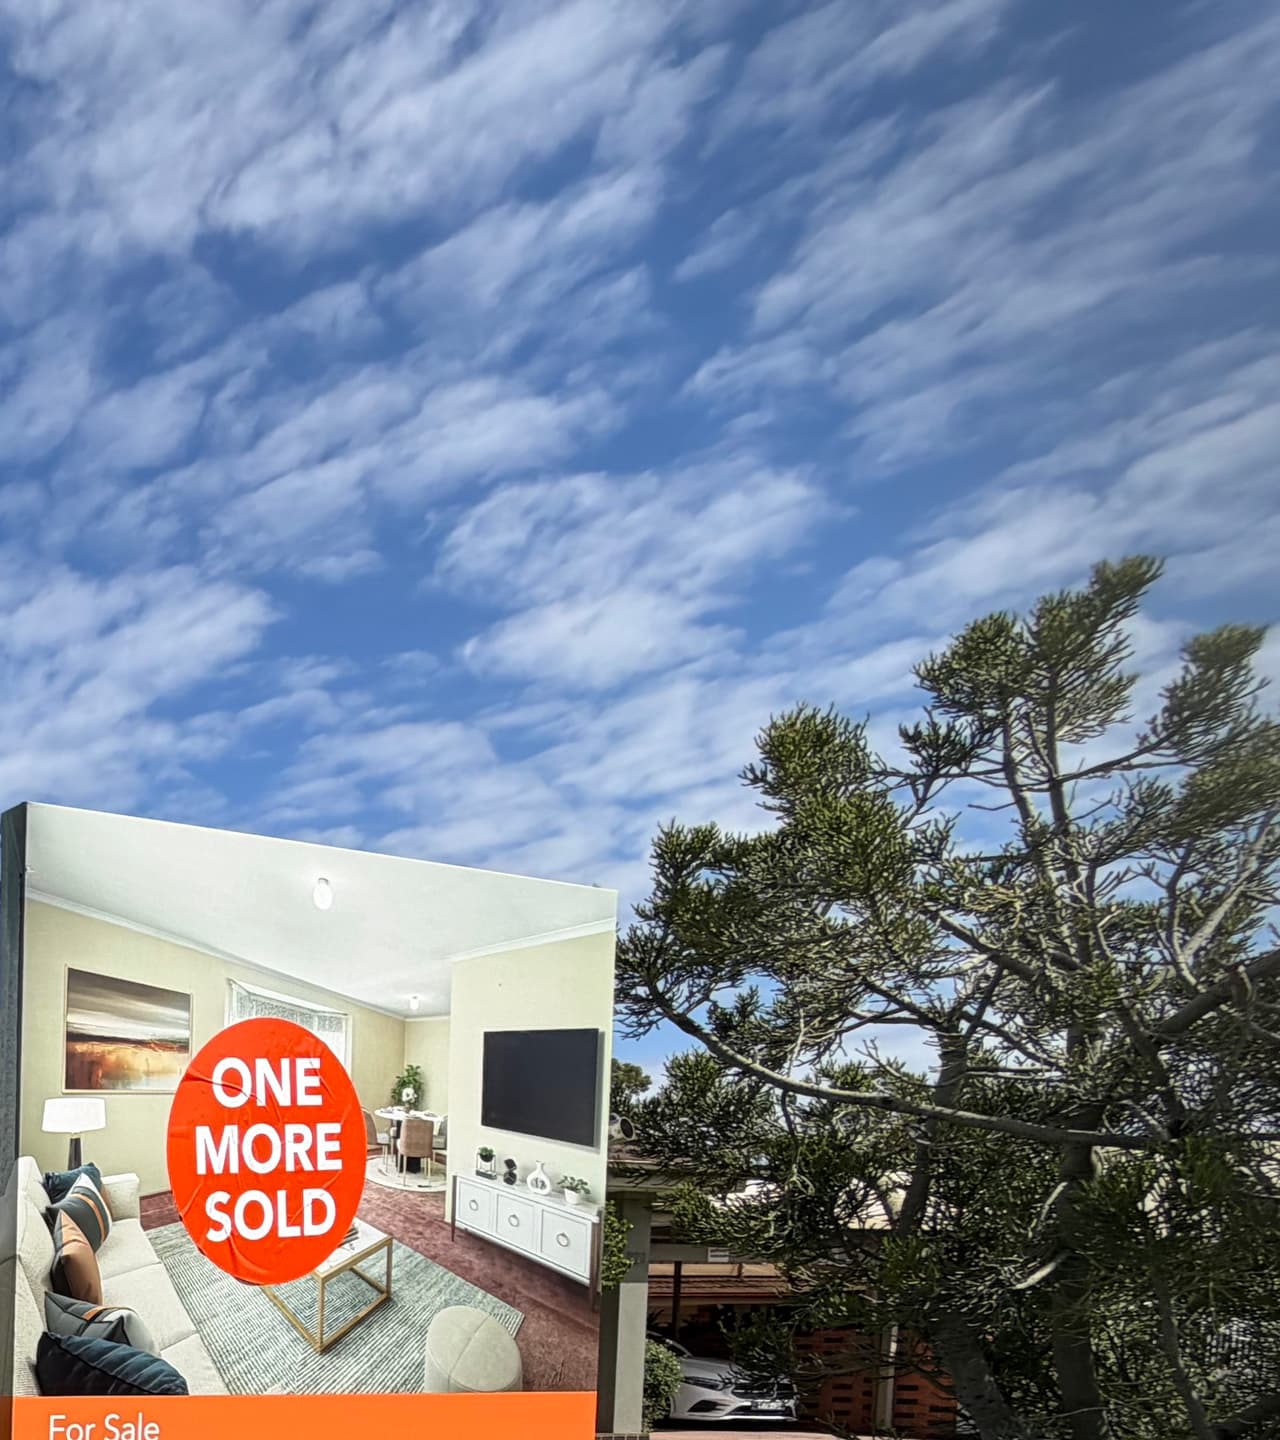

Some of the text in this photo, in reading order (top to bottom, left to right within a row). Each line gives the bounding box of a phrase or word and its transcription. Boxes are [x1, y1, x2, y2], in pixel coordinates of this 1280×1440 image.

[211, 1057, 323, 1108] ONE
[195, 1122, 343, 1175] MORE
[205, 1188, 336, 1242] SOLD
